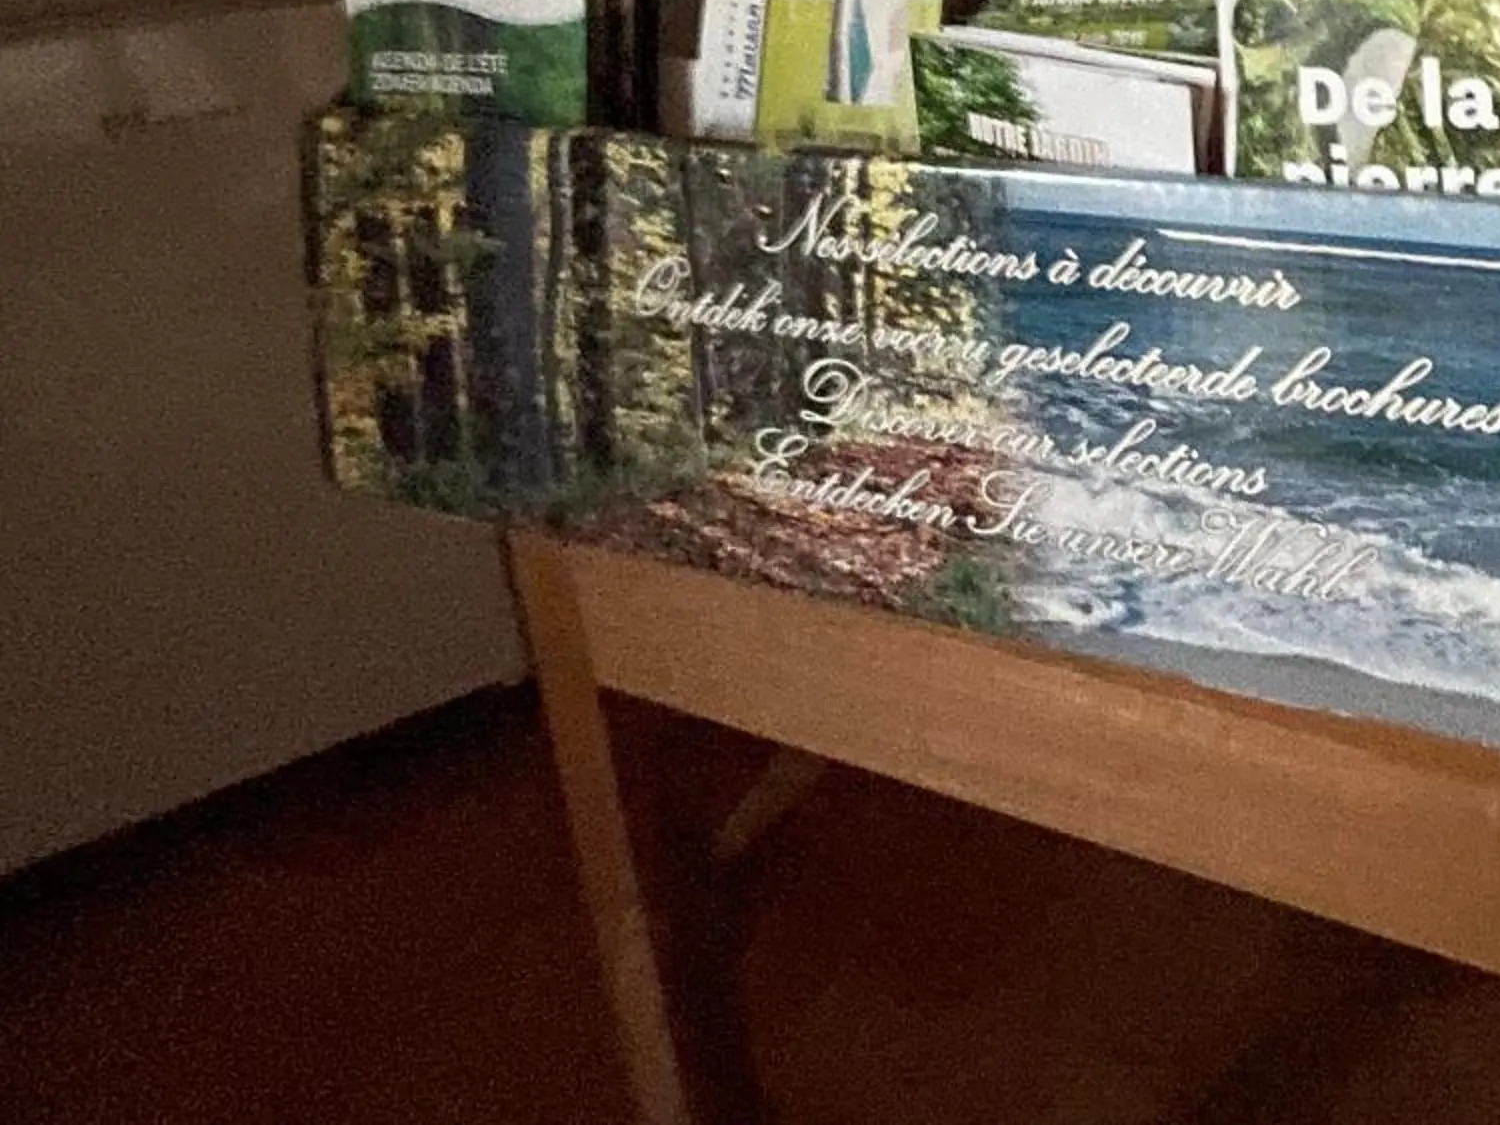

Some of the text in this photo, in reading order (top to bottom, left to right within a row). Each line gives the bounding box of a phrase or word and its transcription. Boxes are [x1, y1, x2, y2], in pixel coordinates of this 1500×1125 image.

[1297, 55, 1500, 132] De la
[759, 192, 855, 261] Nos
[1047, 247, 1082, 286] à
[1088, 236, 1301, 312] découvrir
[634, 256, 784, 333] Ontdek
[993, 321, 1260, 401] geselecteerde
[753, 427, 961, 528] Entdecken
[965, 471, 1050, 545] Sie
[800, 357, 987, 450] Discover
[1066, 418, 1270, 496] selections
